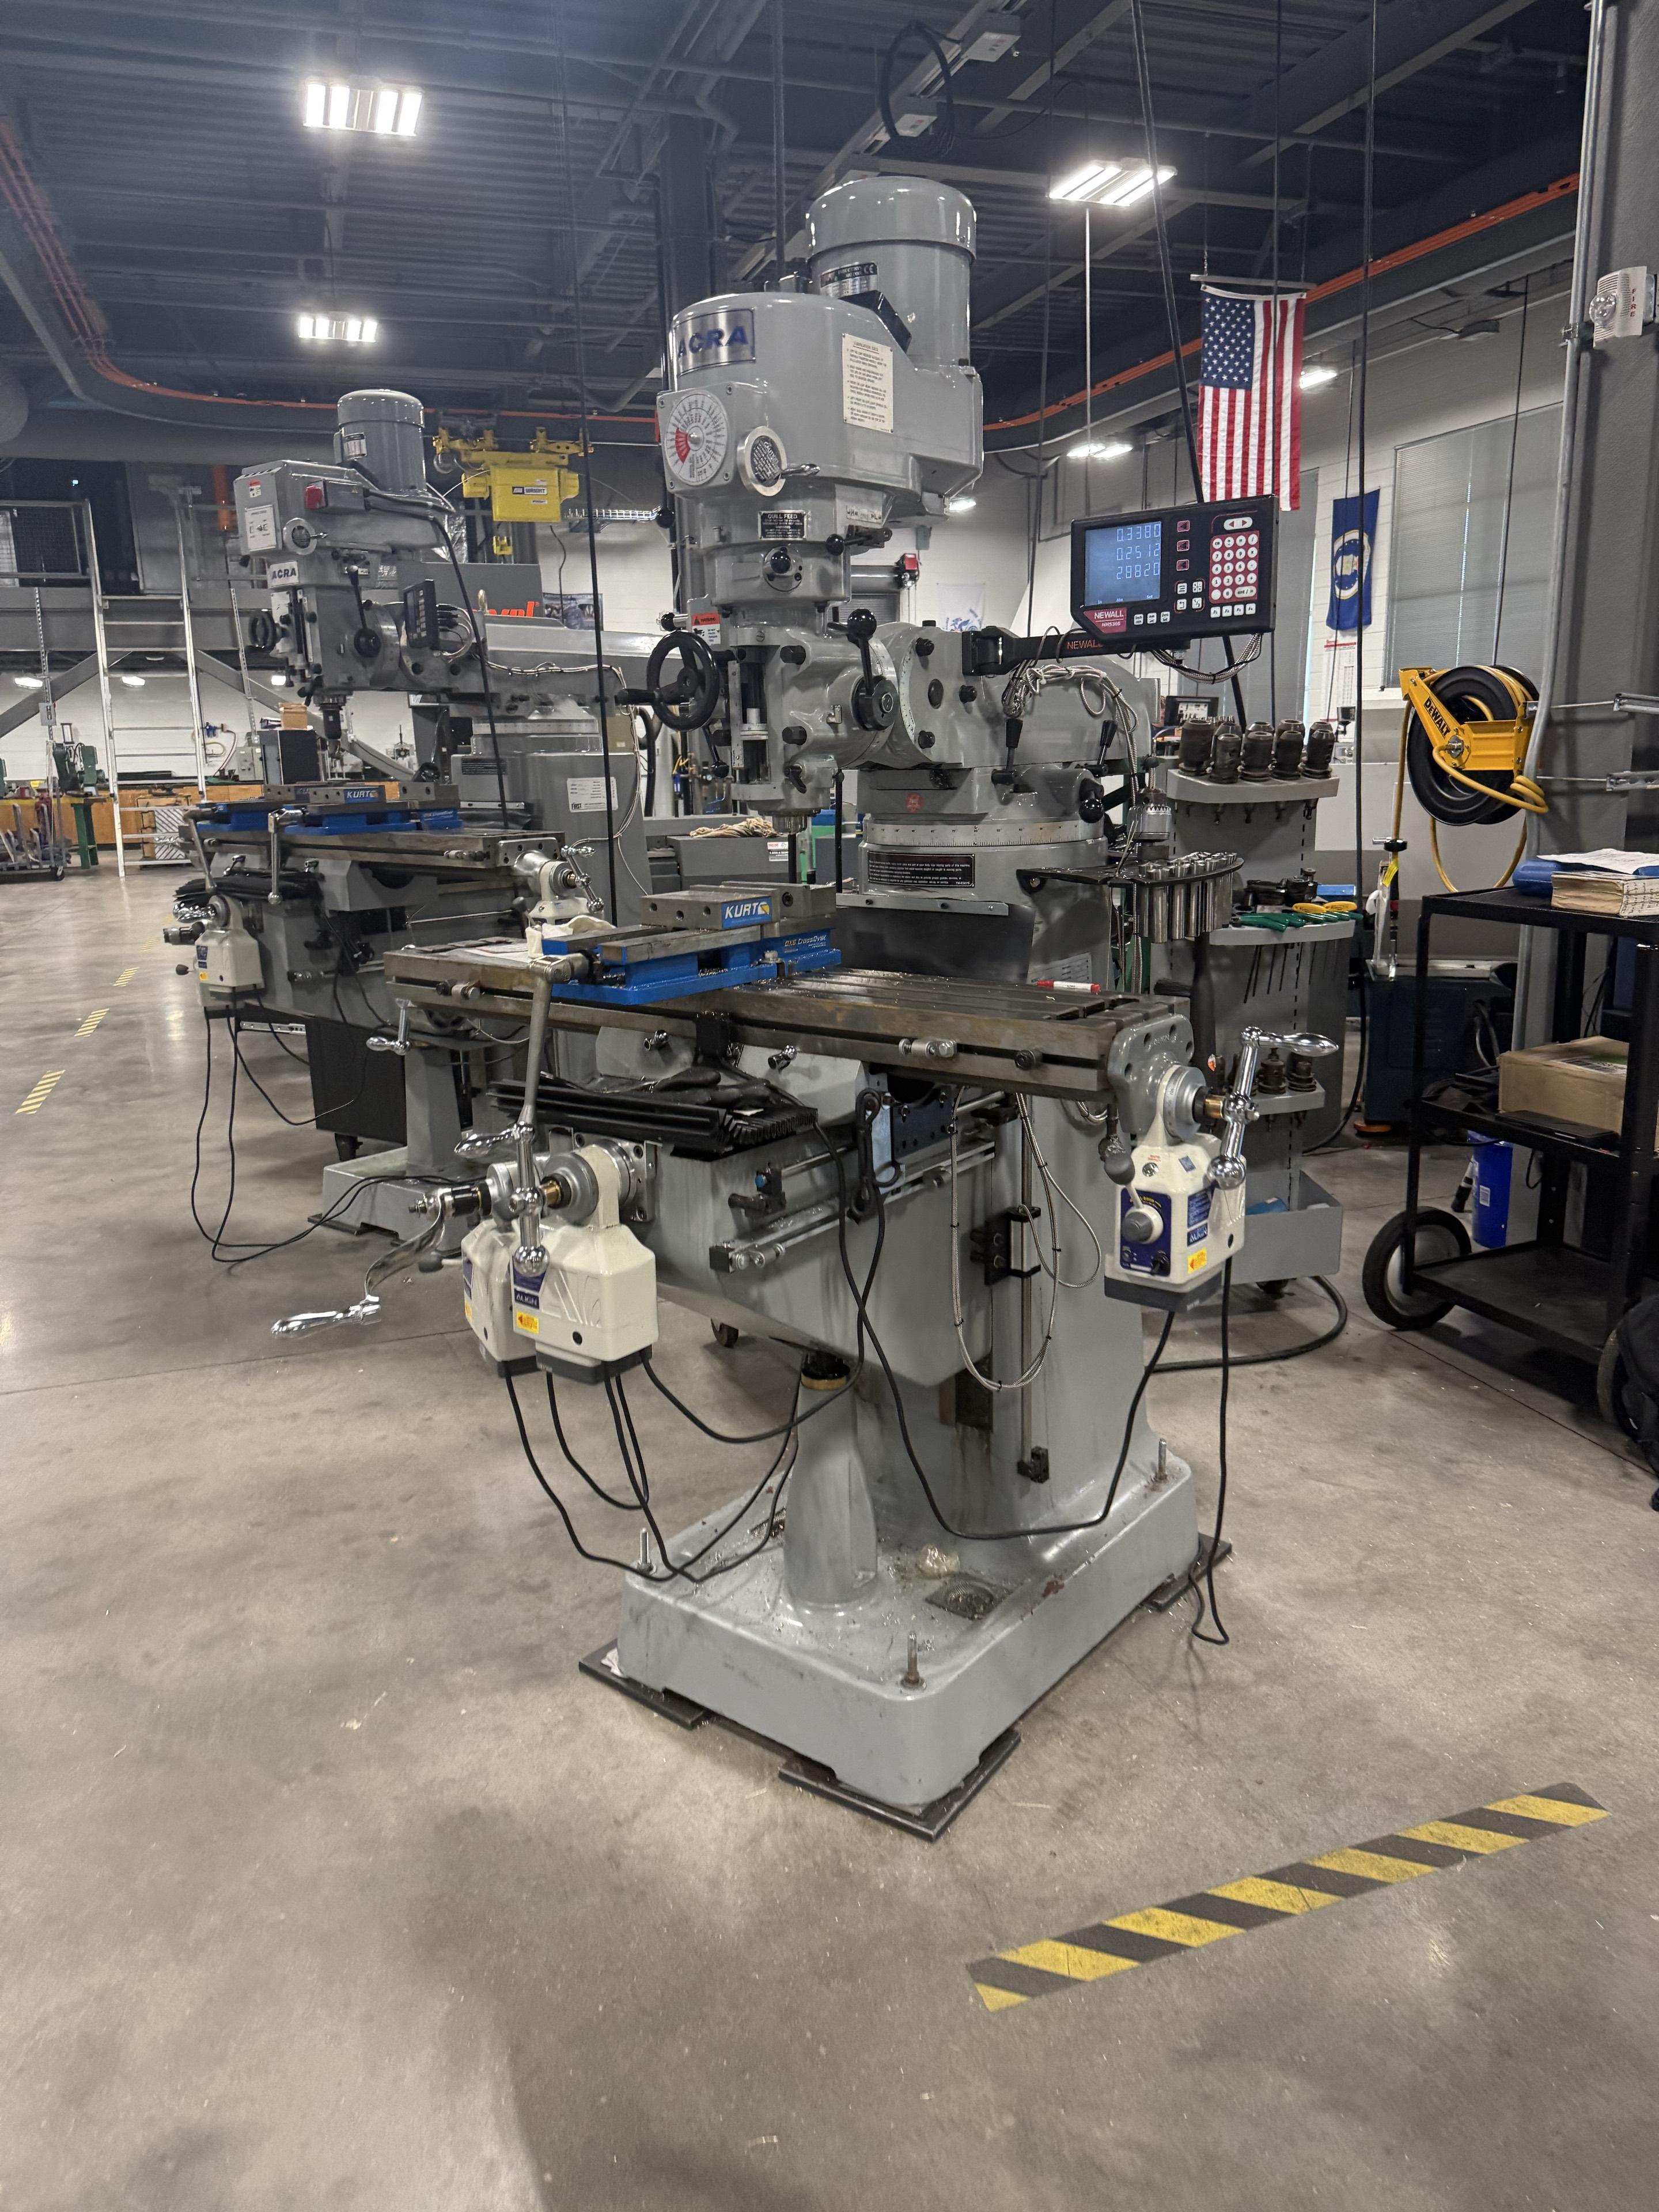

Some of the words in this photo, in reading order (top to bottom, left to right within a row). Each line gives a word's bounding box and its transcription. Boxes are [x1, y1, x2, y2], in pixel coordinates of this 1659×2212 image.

[677, 325, 748, 358] ACRA
[271, 567, 297, 579] ACRA
[1094, 610, 1123, 619] NEWALL
[1066, 639, 1104, 650] NEWAL
[347, 790, 370, 798] KURT
[724, 902, 759, 920] KURT
[516, 1293, 537, 1306] ALIGN
